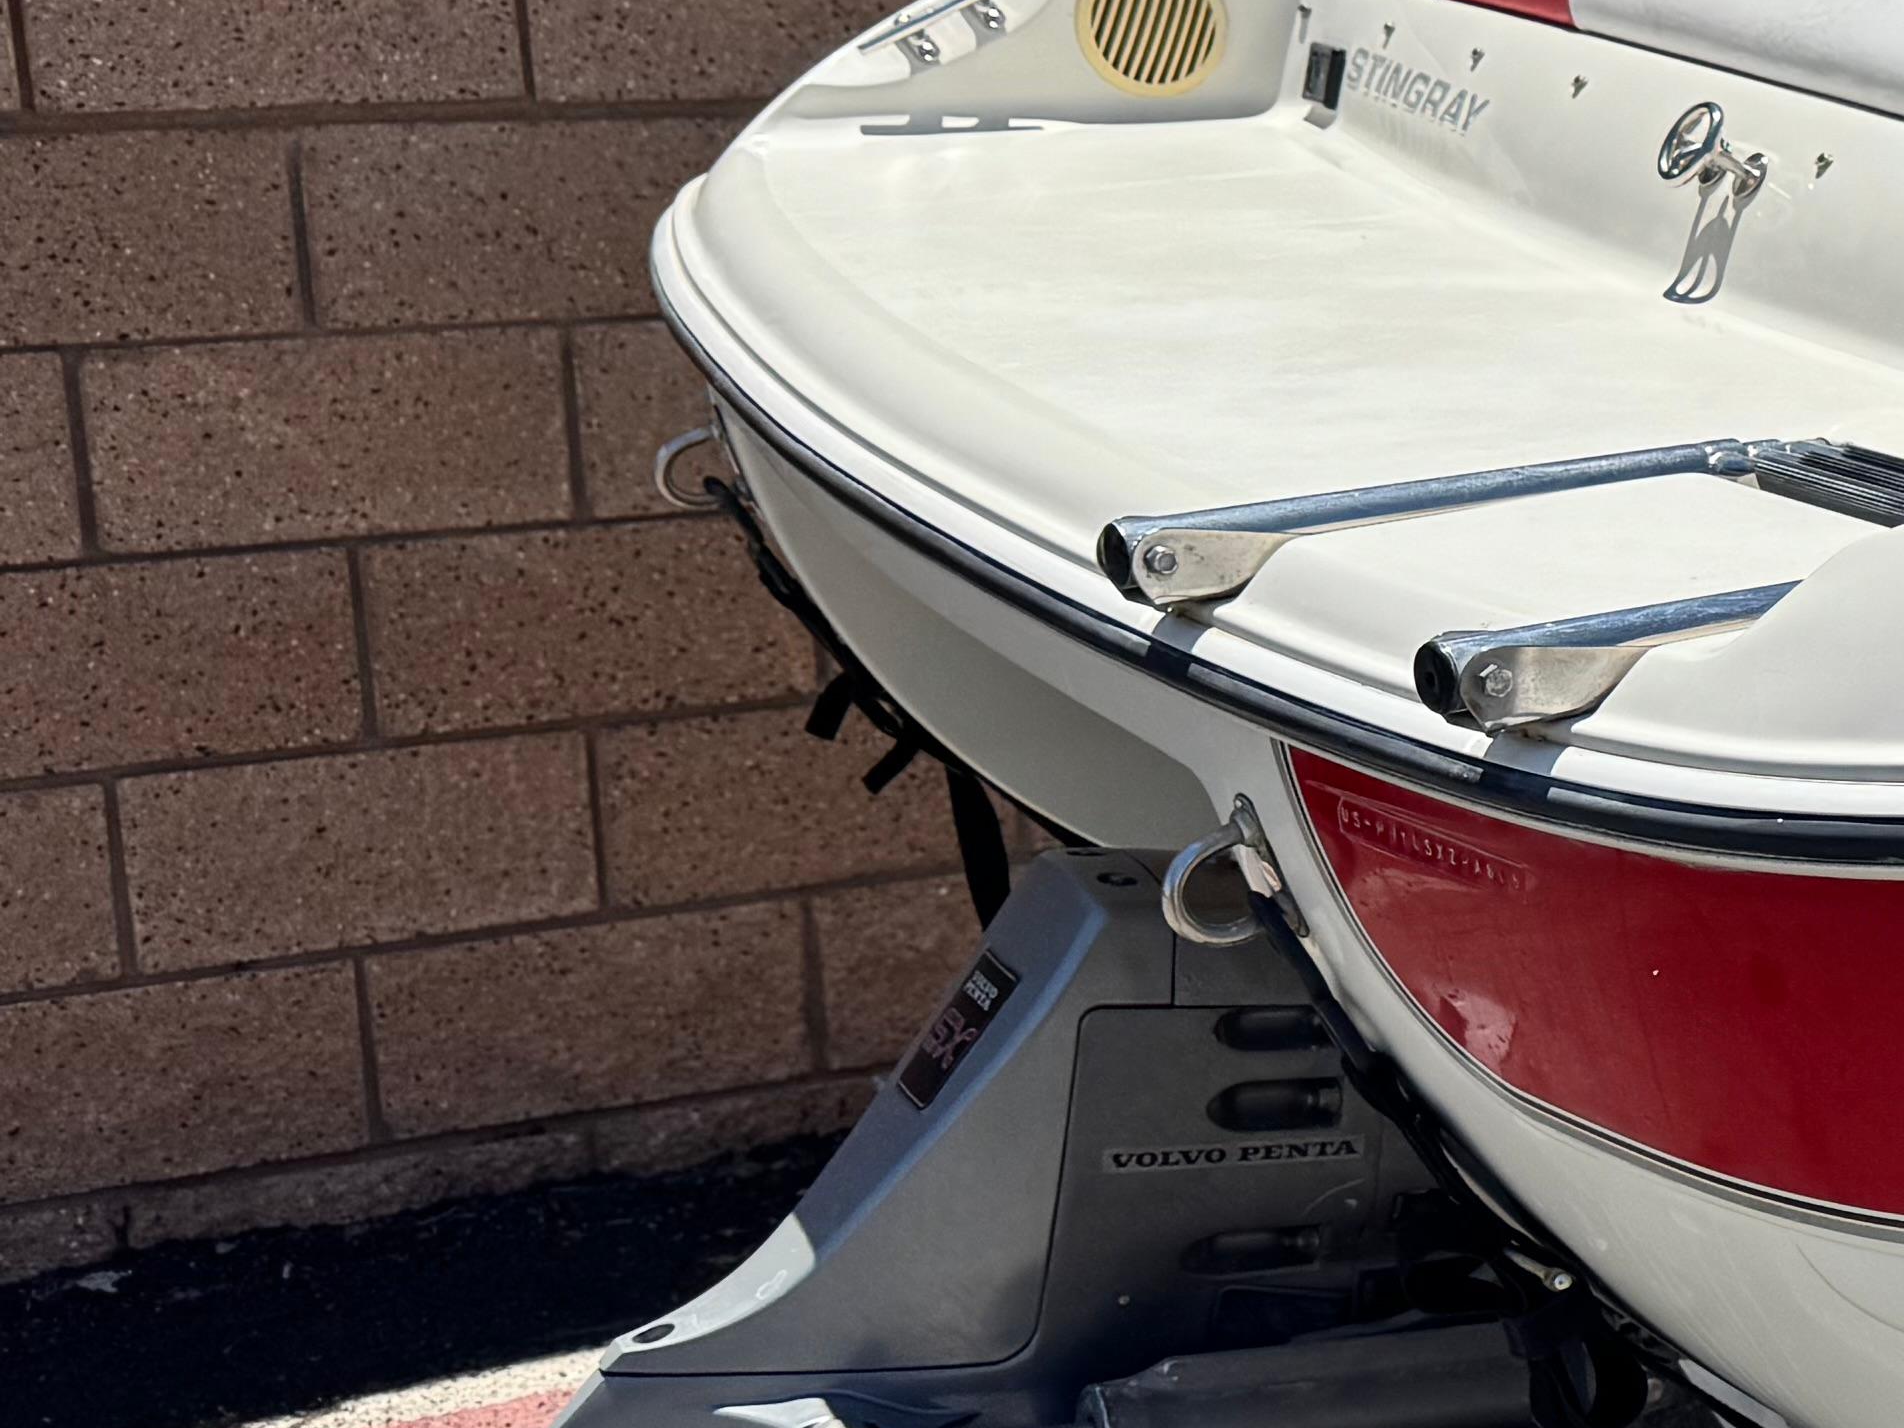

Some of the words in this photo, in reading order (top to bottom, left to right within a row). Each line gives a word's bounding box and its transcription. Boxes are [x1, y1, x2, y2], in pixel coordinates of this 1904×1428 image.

[1347, 47, 1490, 132] STINGRAY
[1111, 1148, 1226, 1169] VOLVO
[1238, 1140, 1357, 1162] PENTA
